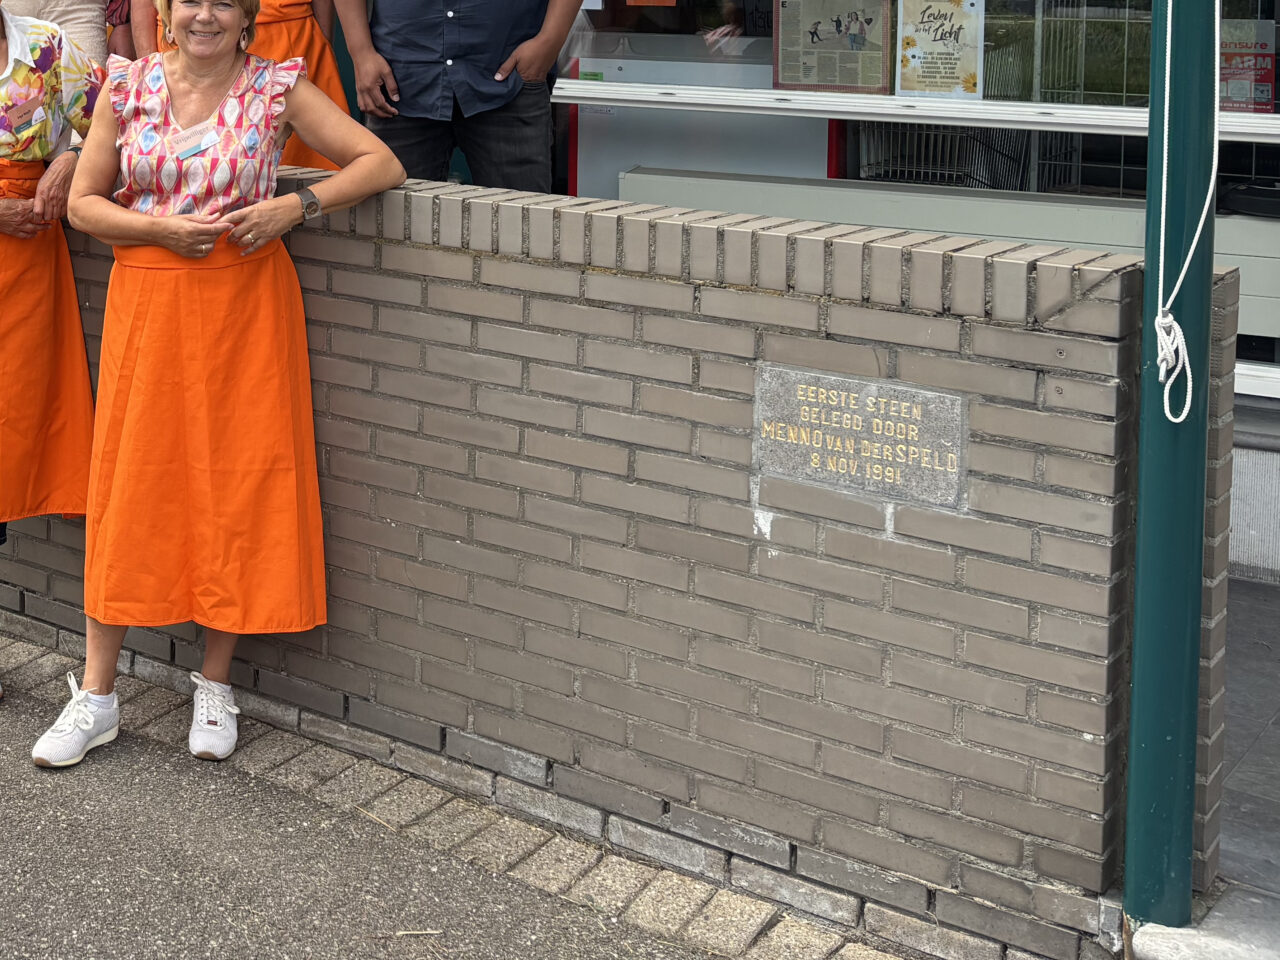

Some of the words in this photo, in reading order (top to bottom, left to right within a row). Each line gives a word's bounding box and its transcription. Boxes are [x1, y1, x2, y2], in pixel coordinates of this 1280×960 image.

[918, 4, 954, 24] Leven
[931, 23, 965, 43] Licht
[1221, 41, 1269, 49] erisure
[1220, 55, 1272, 69] LARM
[797, 384, 859, 409] EERSTE
[866, 396, 922, 420] STEEN
[761, 419, 823, 448] MENNO
[826, 434, 855, 454] VAN
[800, 405, 863, 431] GELEGD
[872, 417, 919, 442] DOOR
[811, 451, 820, 468] 8
[826, 455, 858, 476] NOV
[865, 462, 902, 485] 1991
